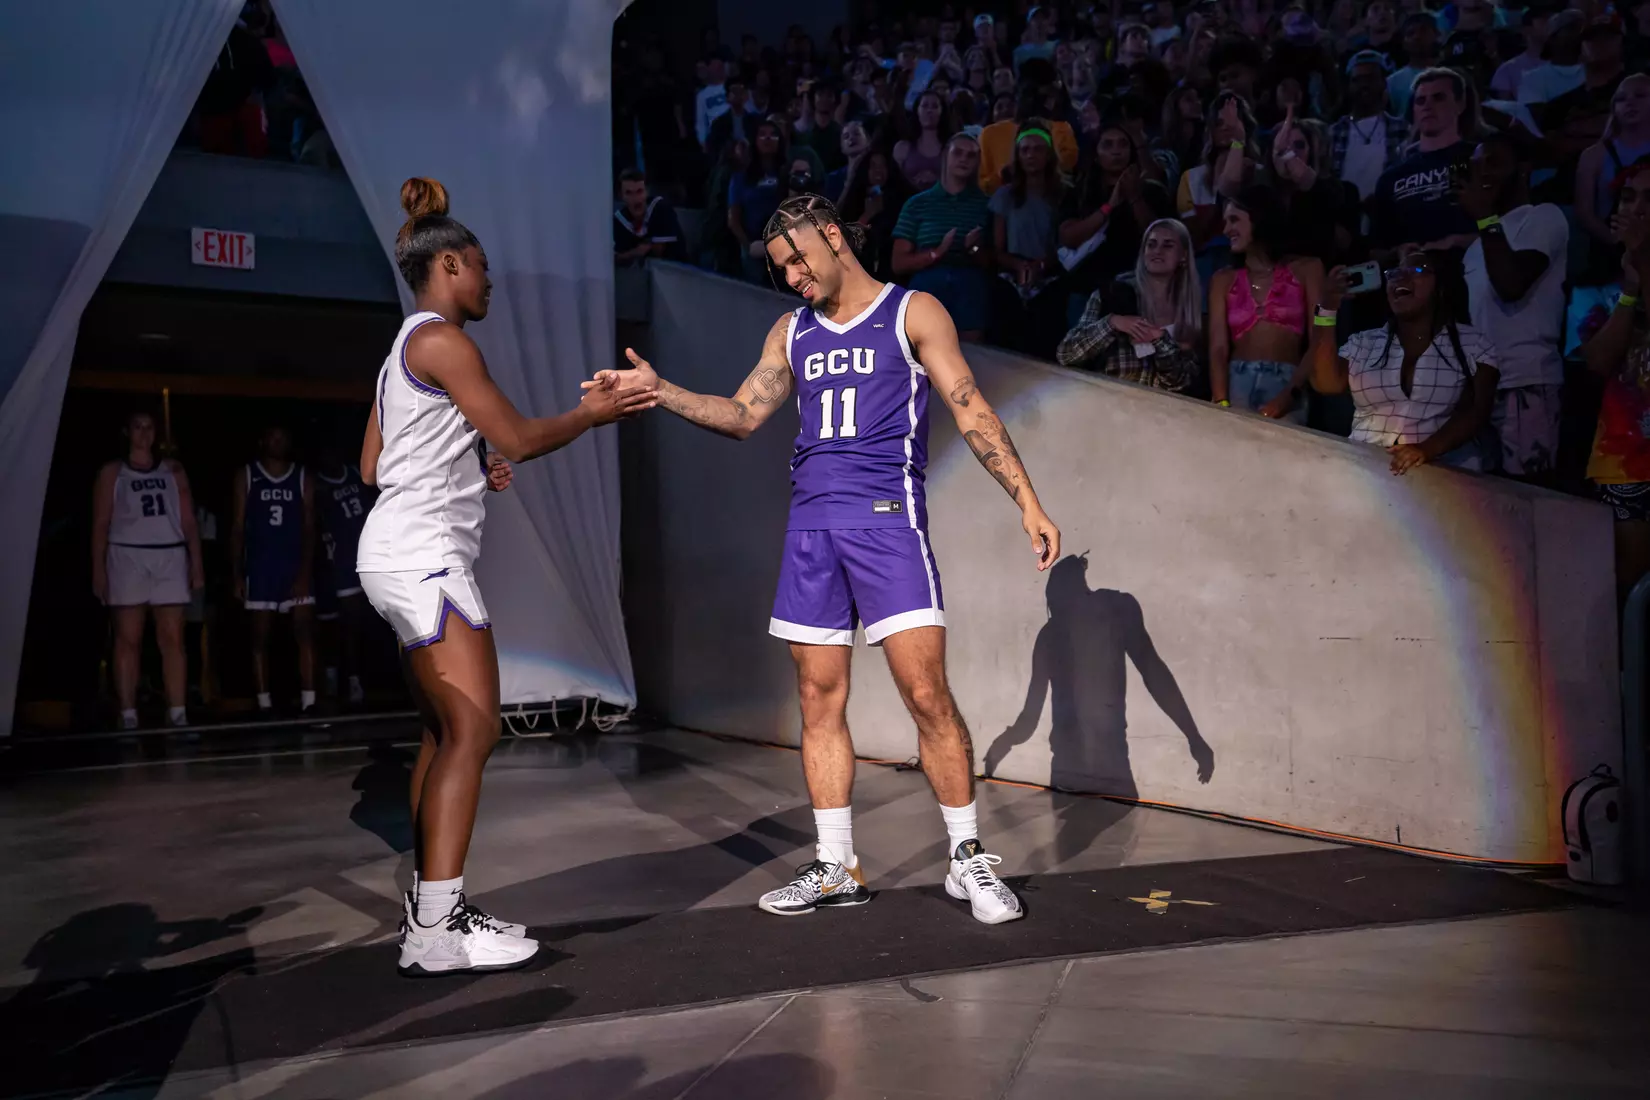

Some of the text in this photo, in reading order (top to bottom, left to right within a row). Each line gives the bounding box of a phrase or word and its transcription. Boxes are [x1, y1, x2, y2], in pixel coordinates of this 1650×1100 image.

[1393, 162, 1469, 193] CANY
[203, 231, 247, 266] EXIT
[804, 347, 876, 382] GCU
[818, 386, 858, 440] 11
[131, 478, 166, 492] GCU
[260, 488, 293, 502] GCU
[333, 483, 360, 501] GCU
[141, 493, 166, 517] 21
[268, 504, 284, 526] 3
[341, 497, 364, 519] 13
